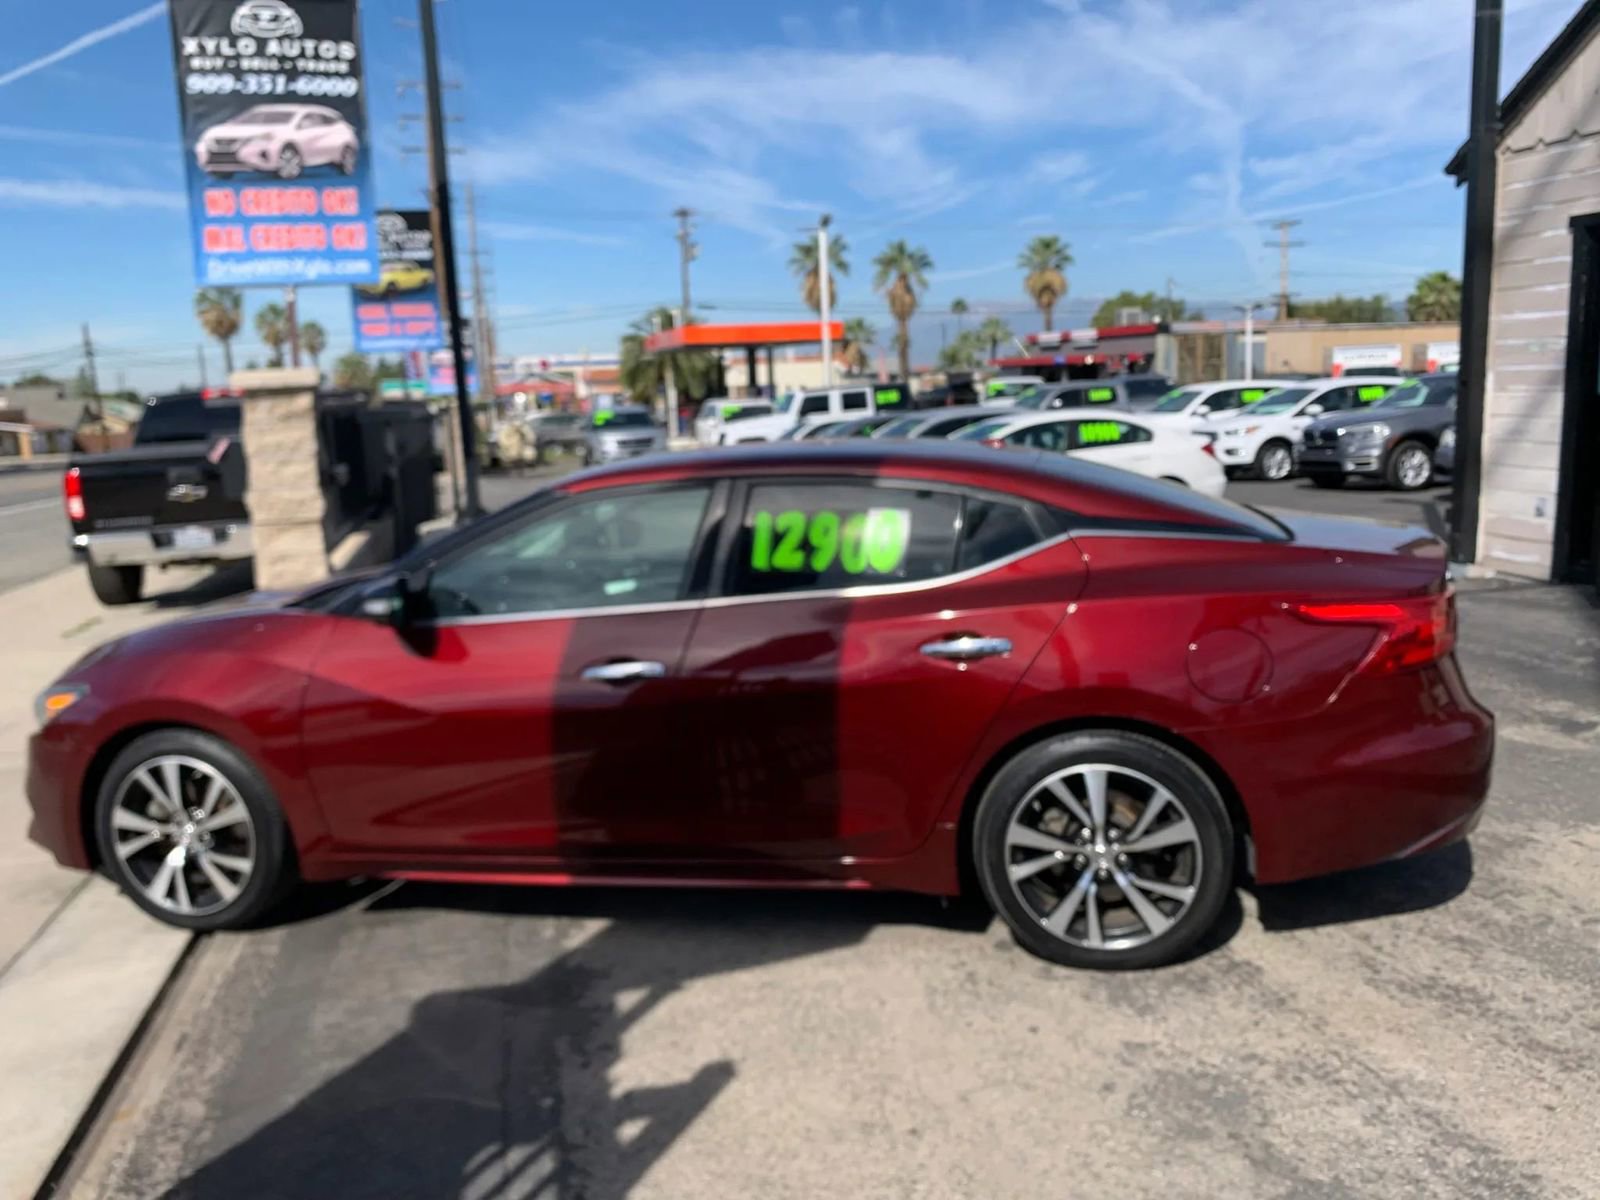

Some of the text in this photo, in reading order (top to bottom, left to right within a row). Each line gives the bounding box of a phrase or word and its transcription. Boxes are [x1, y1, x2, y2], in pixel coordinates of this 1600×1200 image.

[182, 36, 357, 61] XYLO AUTOS
[751, 508, 904, 574] 12900
